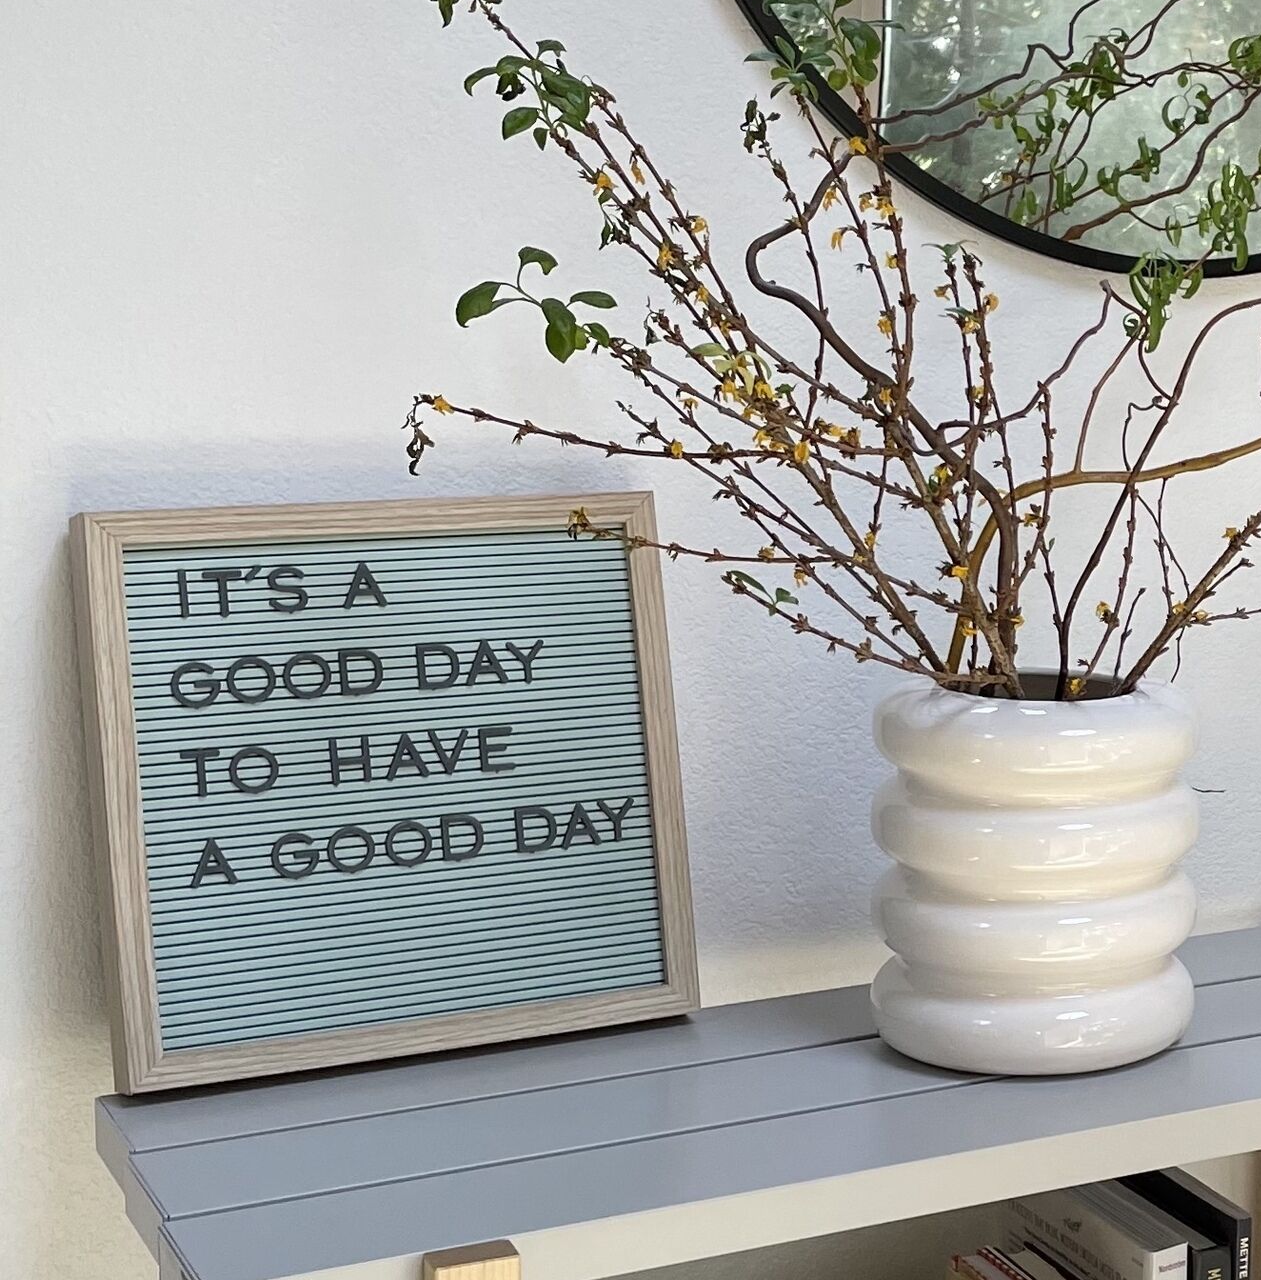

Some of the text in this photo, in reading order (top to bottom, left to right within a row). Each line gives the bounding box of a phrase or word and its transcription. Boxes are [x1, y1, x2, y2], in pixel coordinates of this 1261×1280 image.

[177, 562, 387, 618] IT'S A
[170, 639, 544, 709] GOOD DAY
[180, 726, 516, 797] TO HAVE
[191, 797, 634, 888] A GOOD DAY
[1238, 1236, 1249, 1278] METTE
